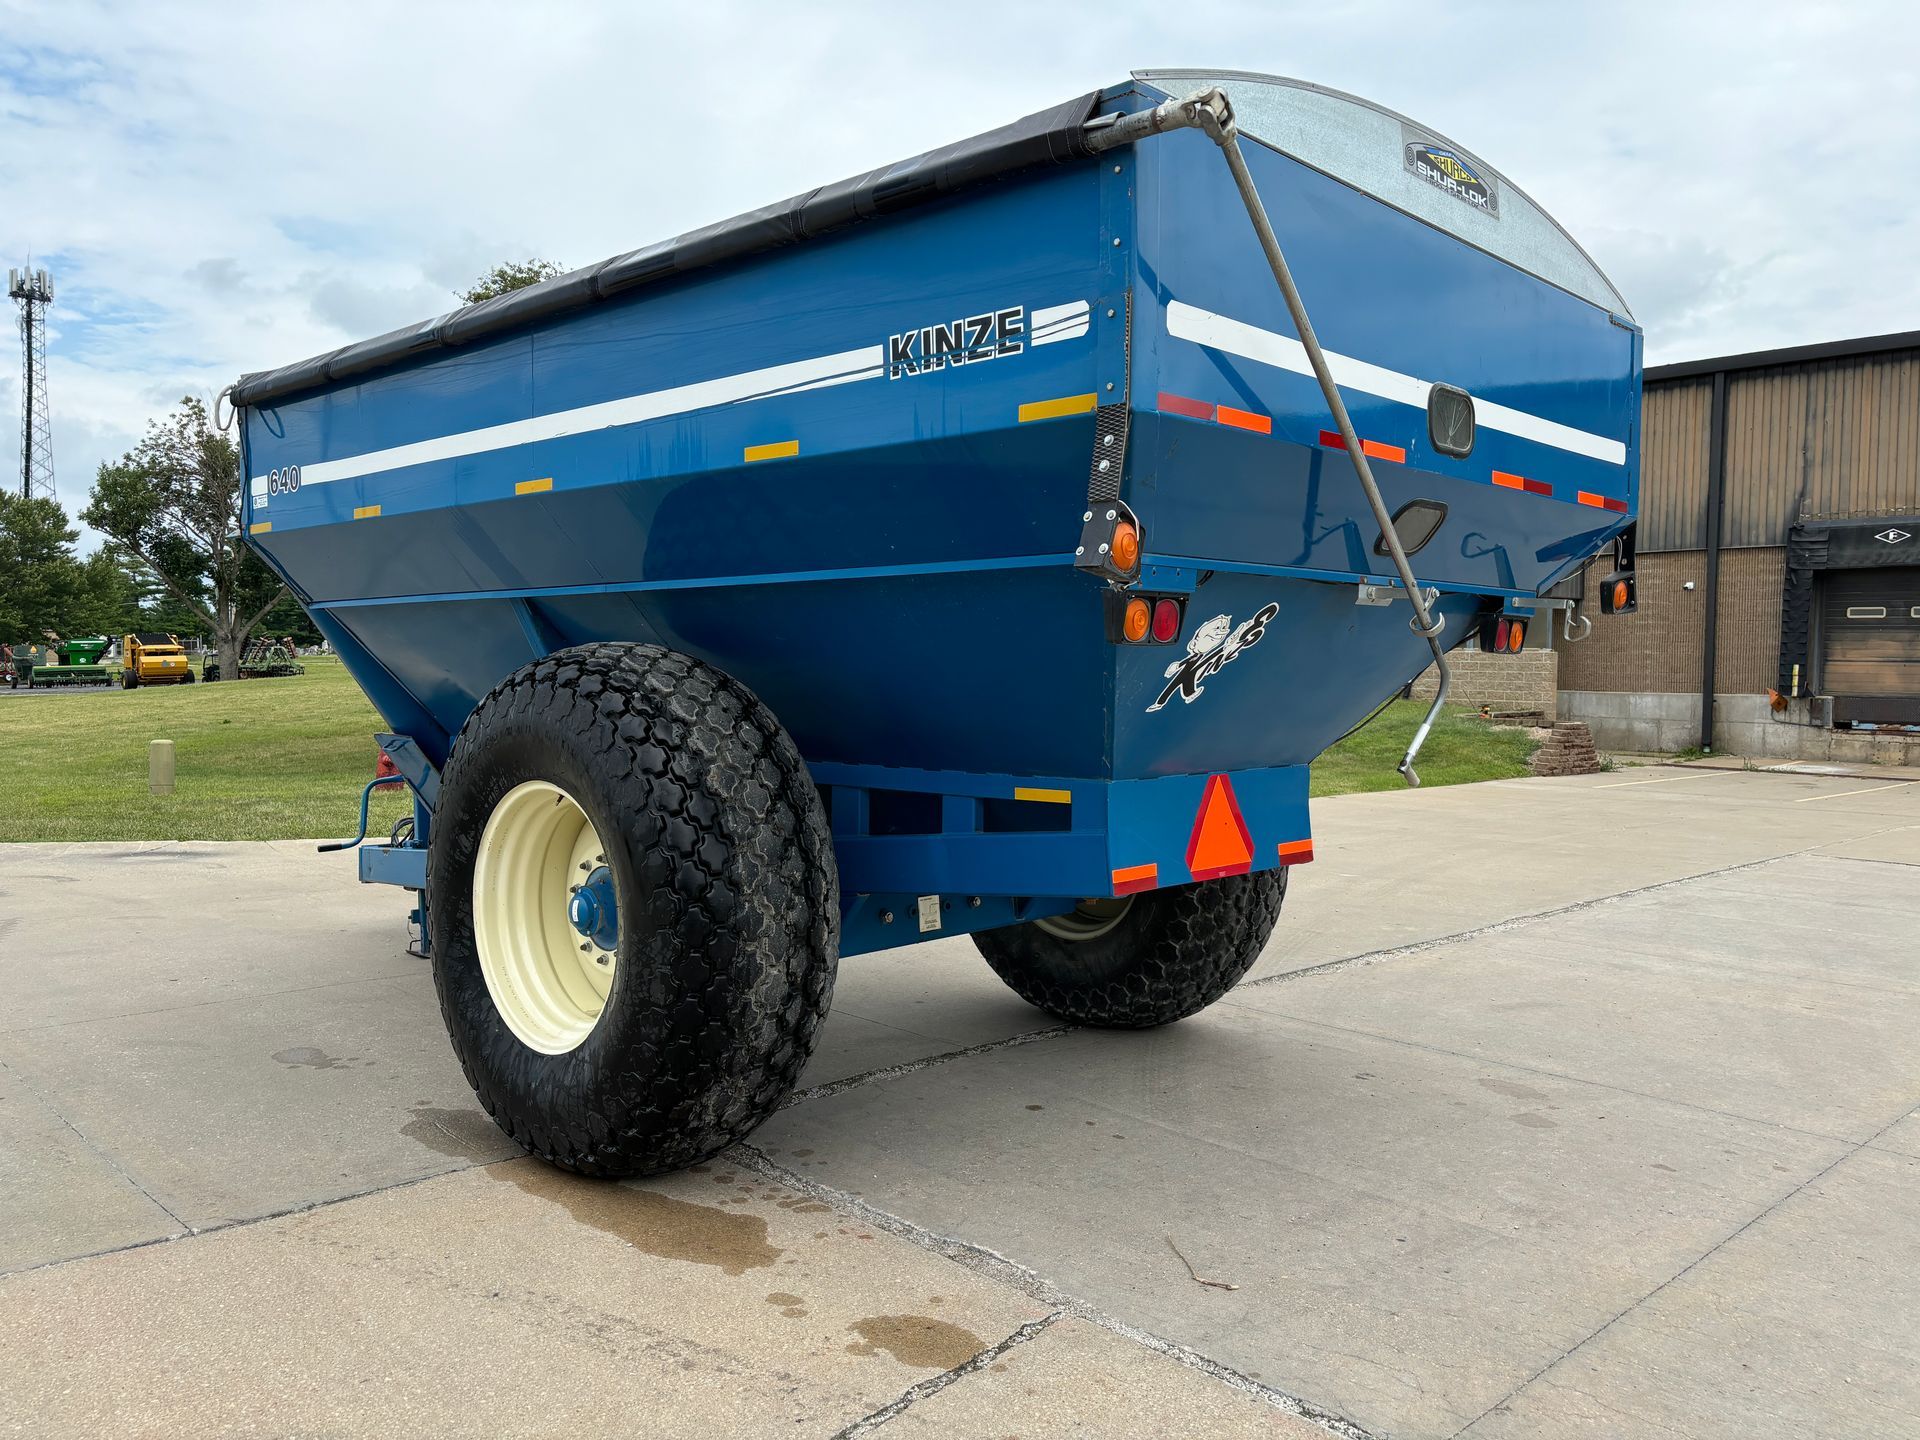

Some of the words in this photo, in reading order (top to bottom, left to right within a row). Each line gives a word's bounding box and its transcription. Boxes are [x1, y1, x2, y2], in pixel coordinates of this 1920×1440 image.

[1416, 161, 1487, 208] SHUR-LOK
[1433, 156, 1472, 182] SHURCO
[889, 305, 1024, 380] KINZE
[269, 464, 300, 496] 640
